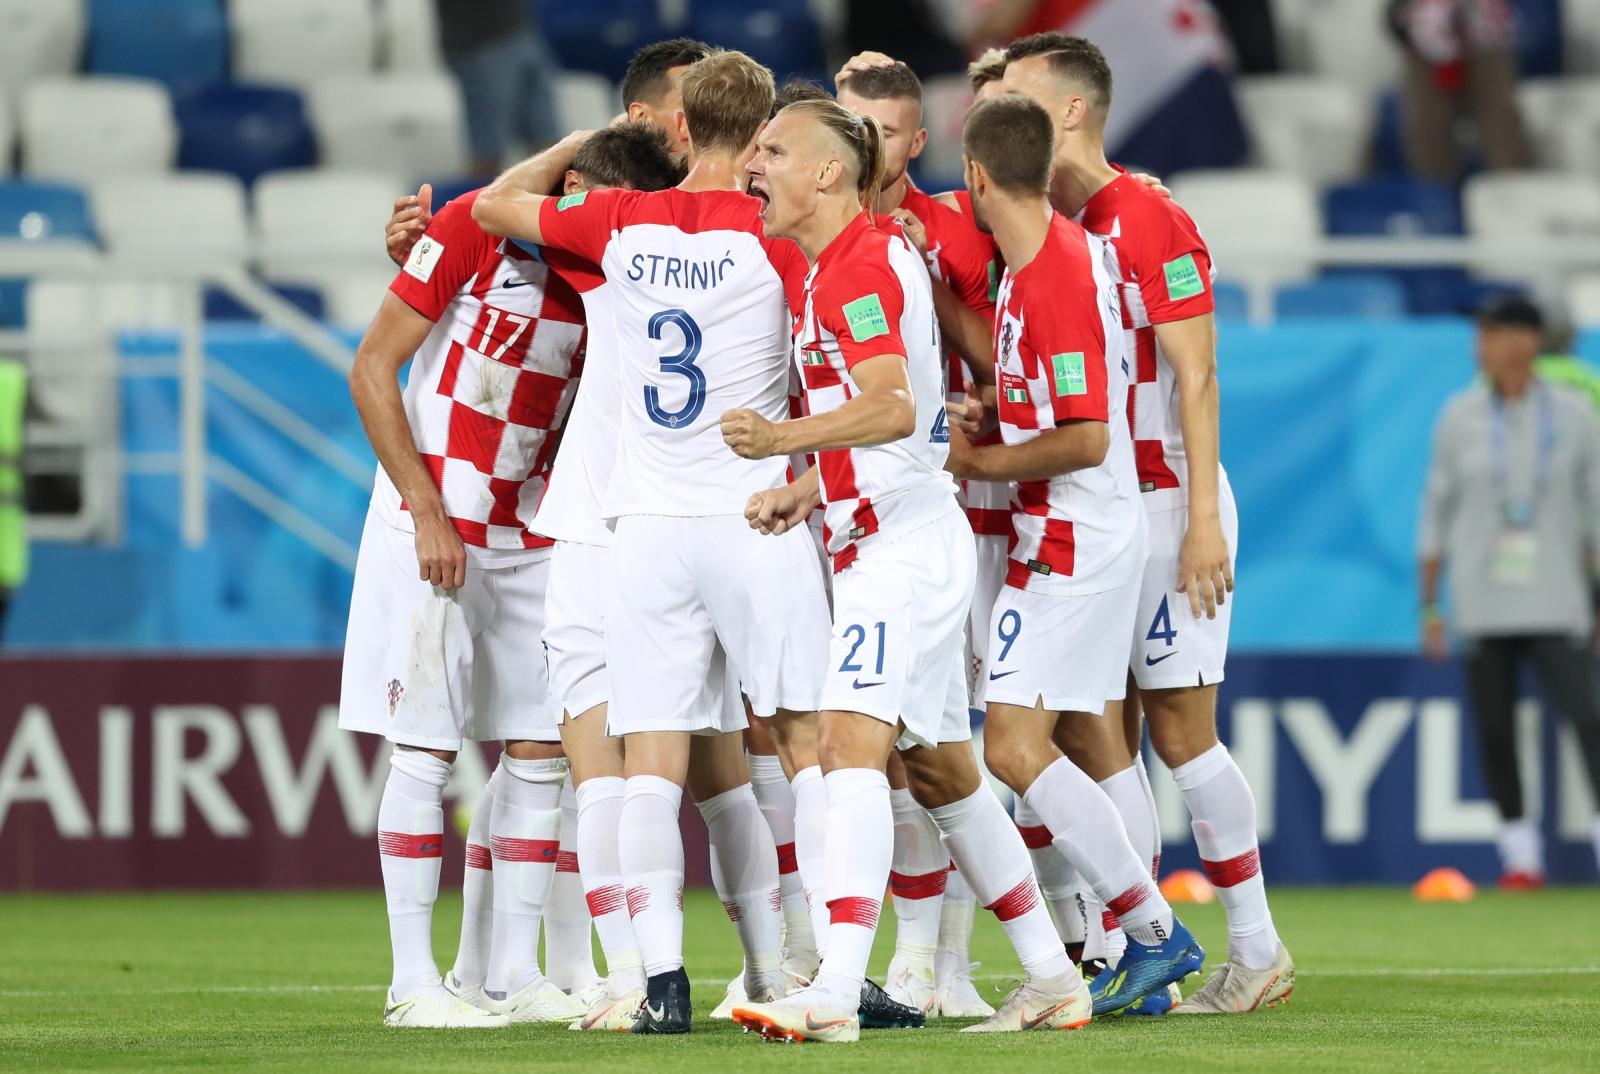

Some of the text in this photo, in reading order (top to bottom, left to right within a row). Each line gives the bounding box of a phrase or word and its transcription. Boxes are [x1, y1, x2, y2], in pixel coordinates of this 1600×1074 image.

[626, 249, 735, 290] STRINIĆ
[477, 308, 530, 360] 17
[643, 309, 707, 429] 3
[998, 608, 1022, 662] 9
[1146, 593, 1178, 647] 4
[838, 621, 885, 675] 21
